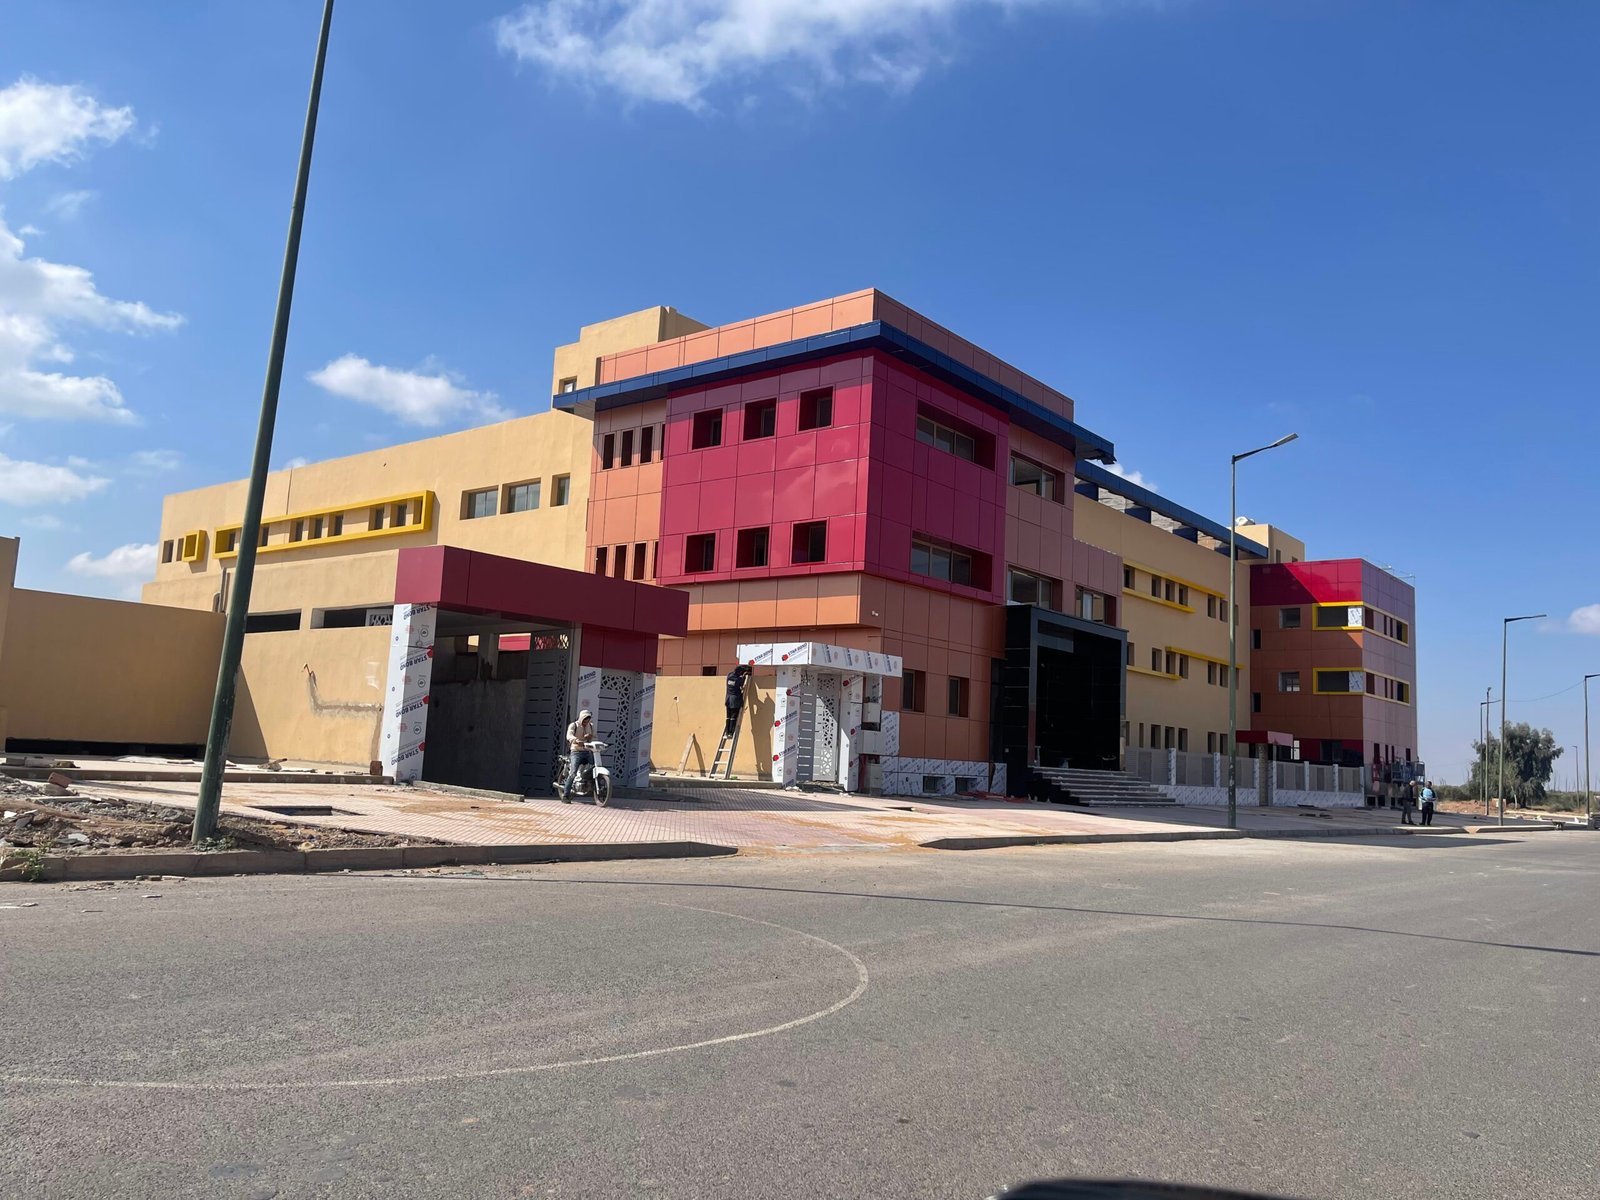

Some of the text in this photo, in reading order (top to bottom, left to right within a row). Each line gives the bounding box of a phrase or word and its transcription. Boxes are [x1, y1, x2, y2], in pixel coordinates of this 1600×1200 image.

[414, 654, 428, 664] STAR
[584, 671, 596, 680] BOND
[396, 702, 423, 718] STAR BOND
[405, 749, 419, 759] STAR
